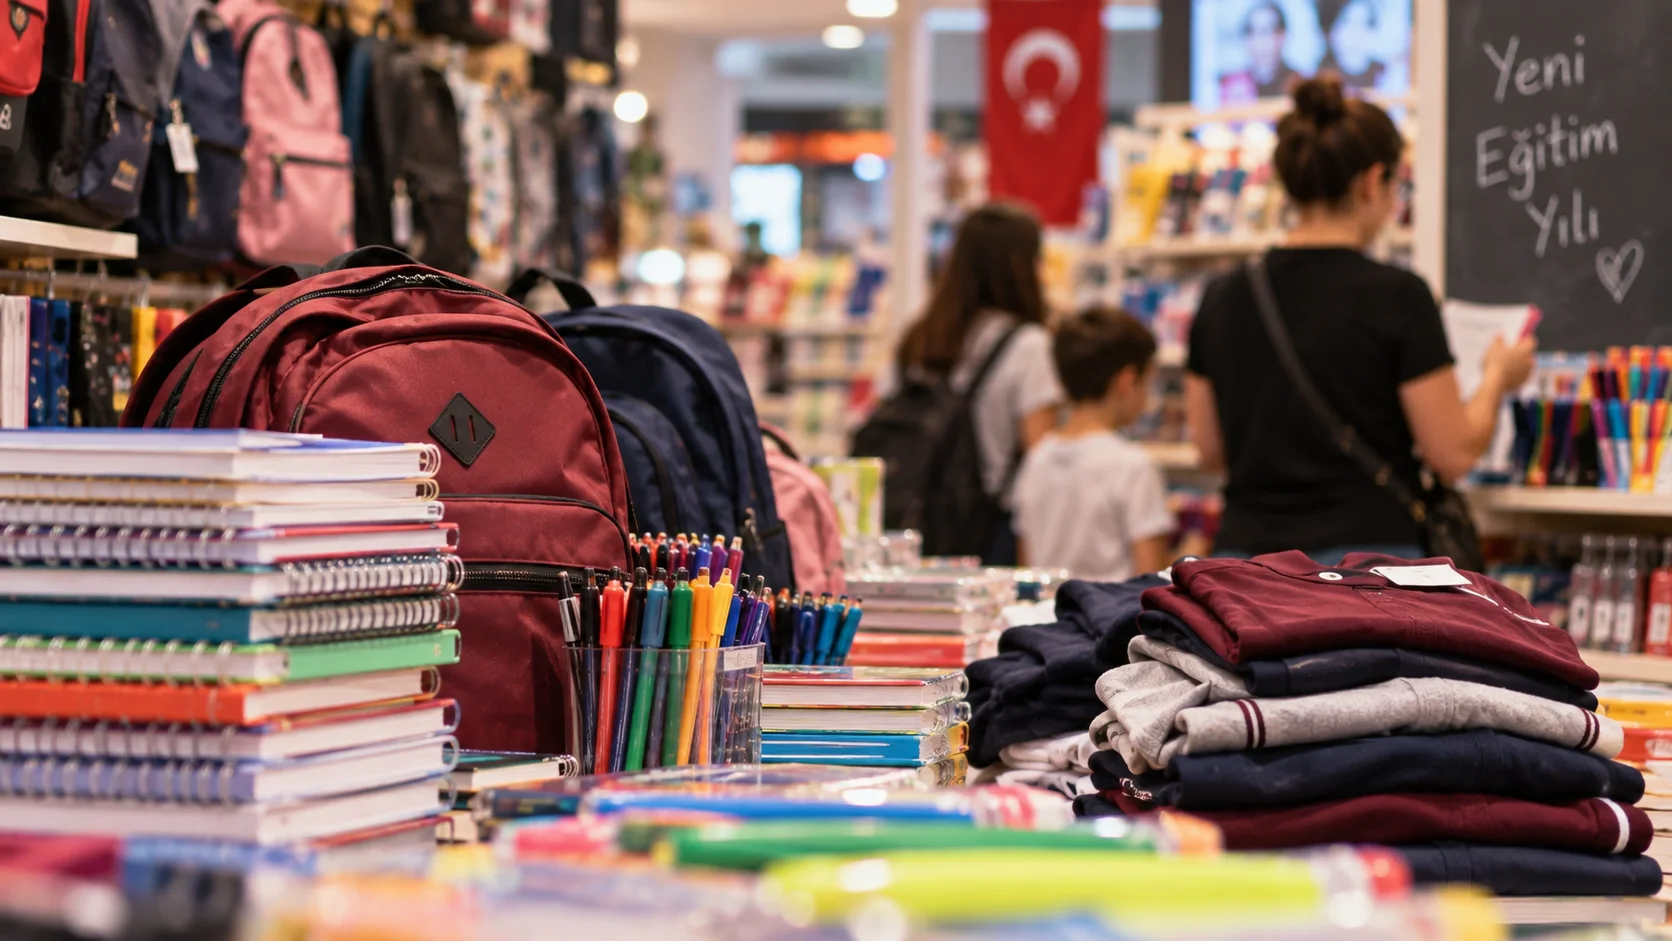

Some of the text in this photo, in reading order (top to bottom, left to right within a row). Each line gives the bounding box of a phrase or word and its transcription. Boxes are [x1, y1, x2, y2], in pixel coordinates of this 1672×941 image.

[1482, 34, 1585, 103] Yeni
[1476, 113, 1618, 201] Eğitim
[1525, 188, 1599, 258] Yılı
